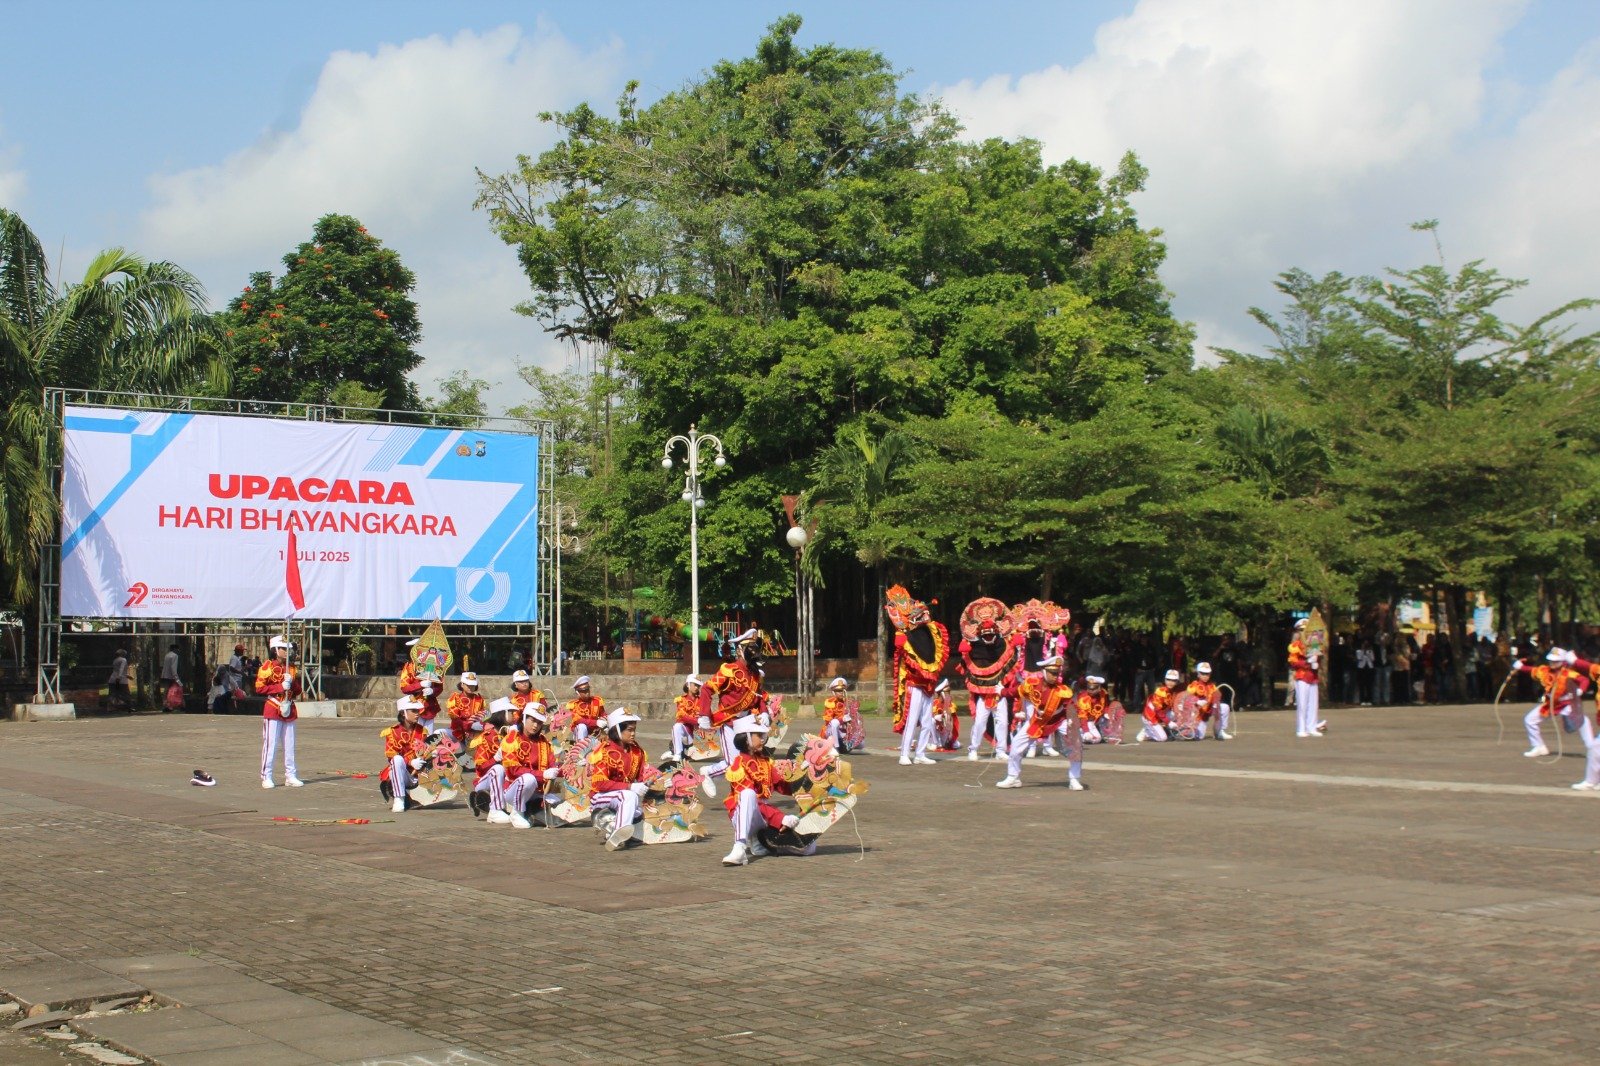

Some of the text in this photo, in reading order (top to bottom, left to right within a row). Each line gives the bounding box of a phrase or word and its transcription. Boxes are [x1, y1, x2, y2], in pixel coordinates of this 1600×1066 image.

[208, 474, 414, 506] UPACARA
[159, 505, 458, 536] HARI BHAYANGKARA
[279, 550, 350, 562] 1 ULI 2025
